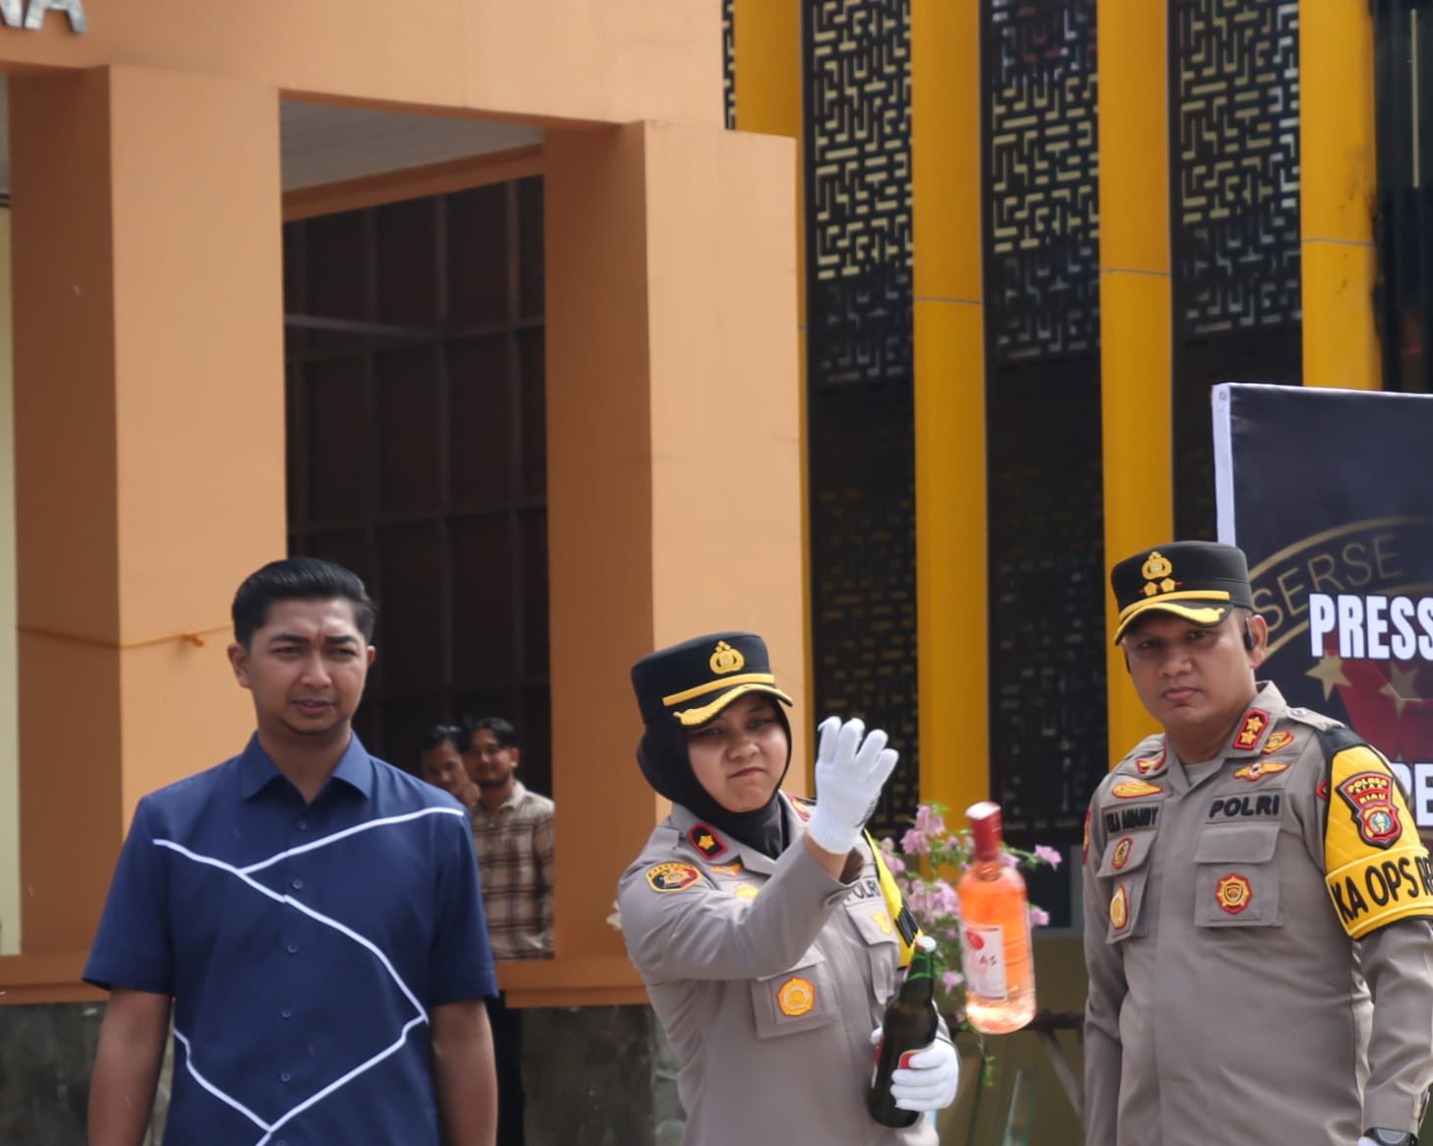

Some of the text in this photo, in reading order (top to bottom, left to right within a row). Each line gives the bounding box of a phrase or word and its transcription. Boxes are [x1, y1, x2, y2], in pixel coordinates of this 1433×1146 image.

[1209, 794, 1281, 819] POLRI
[1330, 876, 1369, 924] KA
[1364, 857, 1419, 907] OPS
